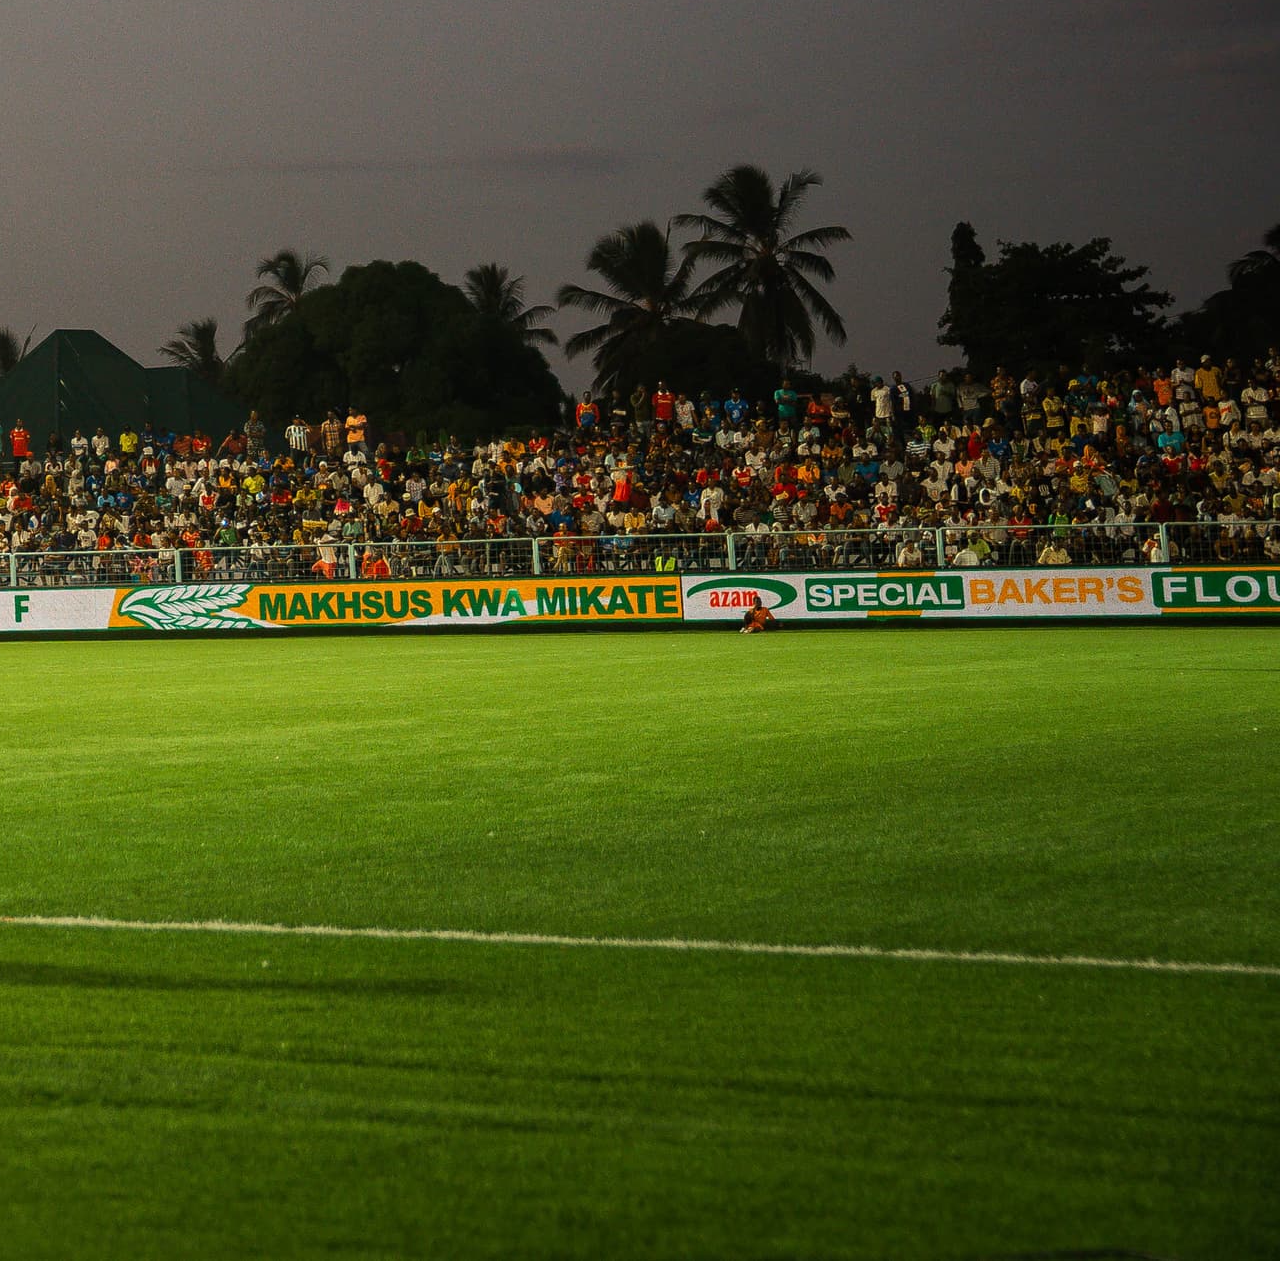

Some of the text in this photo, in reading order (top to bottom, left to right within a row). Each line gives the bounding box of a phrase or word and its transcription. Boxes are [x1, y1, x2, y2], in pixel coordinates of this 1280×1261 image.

[259, 585, 679, 621] MAKHSUS KWA MIKATE
[710, 590, 758, 607] azam
[809, 583, 962, 607] SPECIAL
[969, 576, 1144, 605] BAKER'S
[14, 595, 30, 623] F
